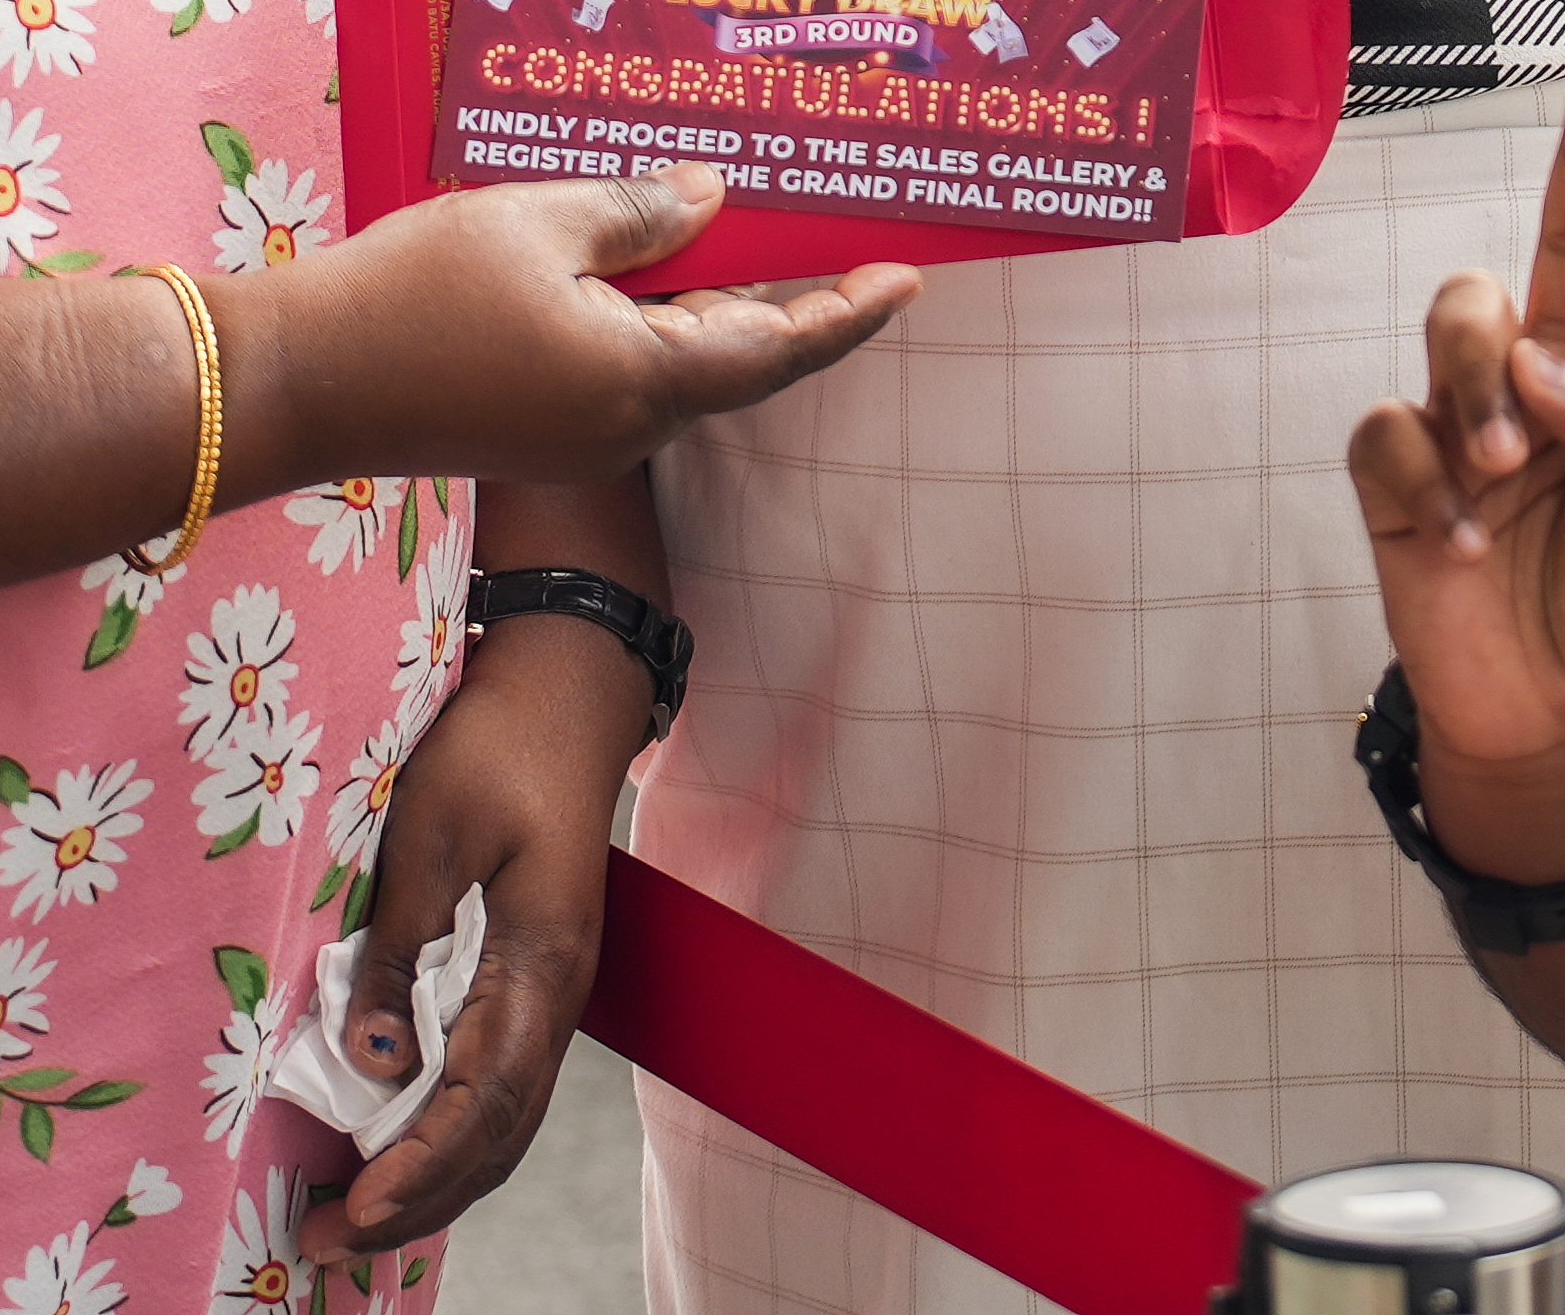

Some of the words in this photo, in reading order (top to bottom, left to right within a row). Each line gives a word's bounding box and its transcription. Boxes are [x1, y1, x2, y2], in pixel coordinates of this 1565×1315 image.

[428, 8, 439, 40] BATU
[735, 24, 797, 49] 3RD
[807, 20, 920, 46] ROUND
[430, 43, 441, 87] CAVES,
[456, 107, 578, 140] KINDLY
[584, 118, 743, 156] PROCEED
[751, 132, 796, 160] TO
[804, 137, 869, 166] THE
[875, 143, 979, 176] SALES
[986, 153, 1137, 190] GALLERY
[1143, 166, 1167, 192] &
[463, 139, 623, 177] REGISTER
[780, 168, 898, 201] GRAND
[906, 177, 1003, 210] FINAL
[1011, 187, 1154, 223] ROUND!!
